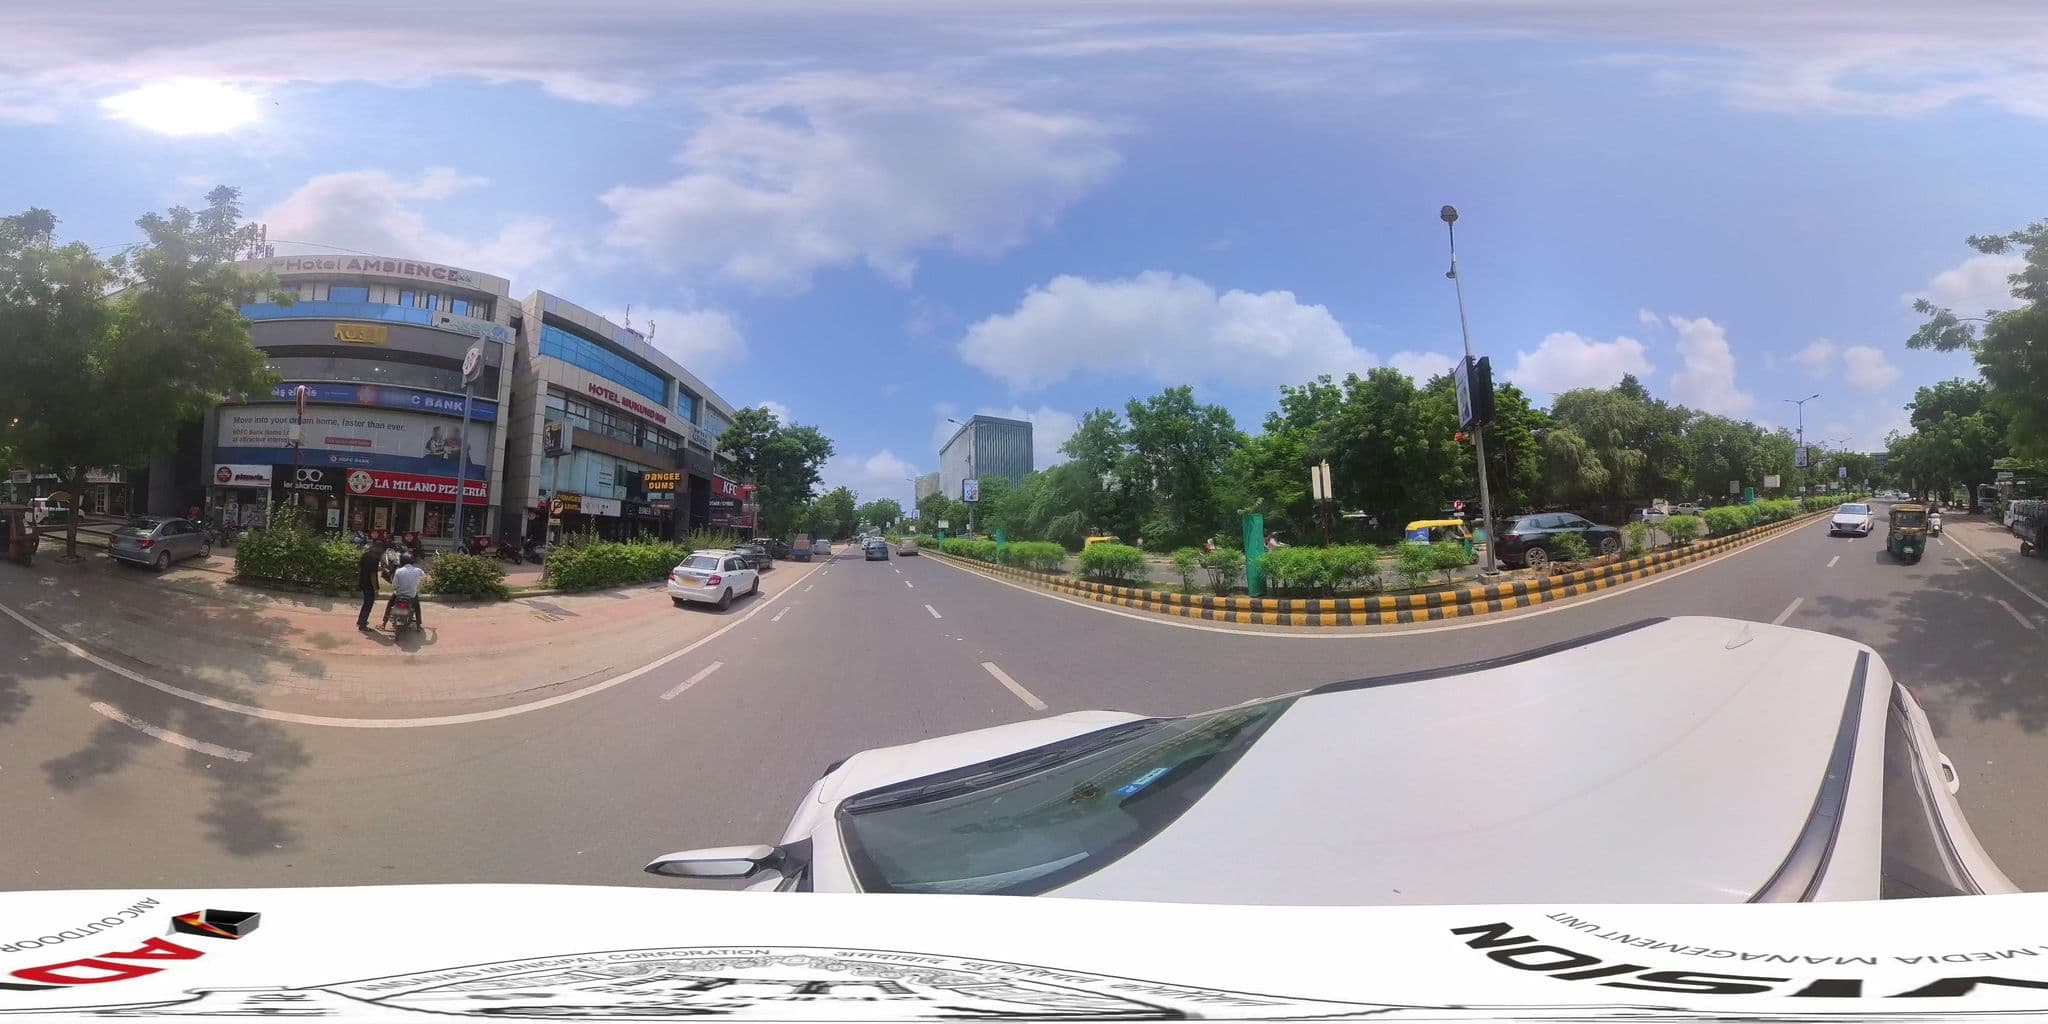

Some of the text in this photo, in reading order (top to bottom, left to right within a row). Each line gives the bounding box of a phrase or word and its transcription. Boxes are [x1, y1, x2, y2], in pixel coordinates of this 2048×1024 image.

[286, 258, 341, 272] Hotel
[347, 258, 459, 282] AMBIENCE
[424, 397, 463, 413] BANK
[588, 382, 621, 404] HOTEL
[621, 396, 655, 419] MUKUND
[233, 416, 254, 424] Move
[254, 416, 269, 424] into
[270, 417, 288, 425] your
[342, 418, 365, 428] faster
[367, 419, 385, 430] than
[374, 478, 390, 489] LA
[393, 480, 437, 493] MILANO
[722, 481, 738, 496] KFC
